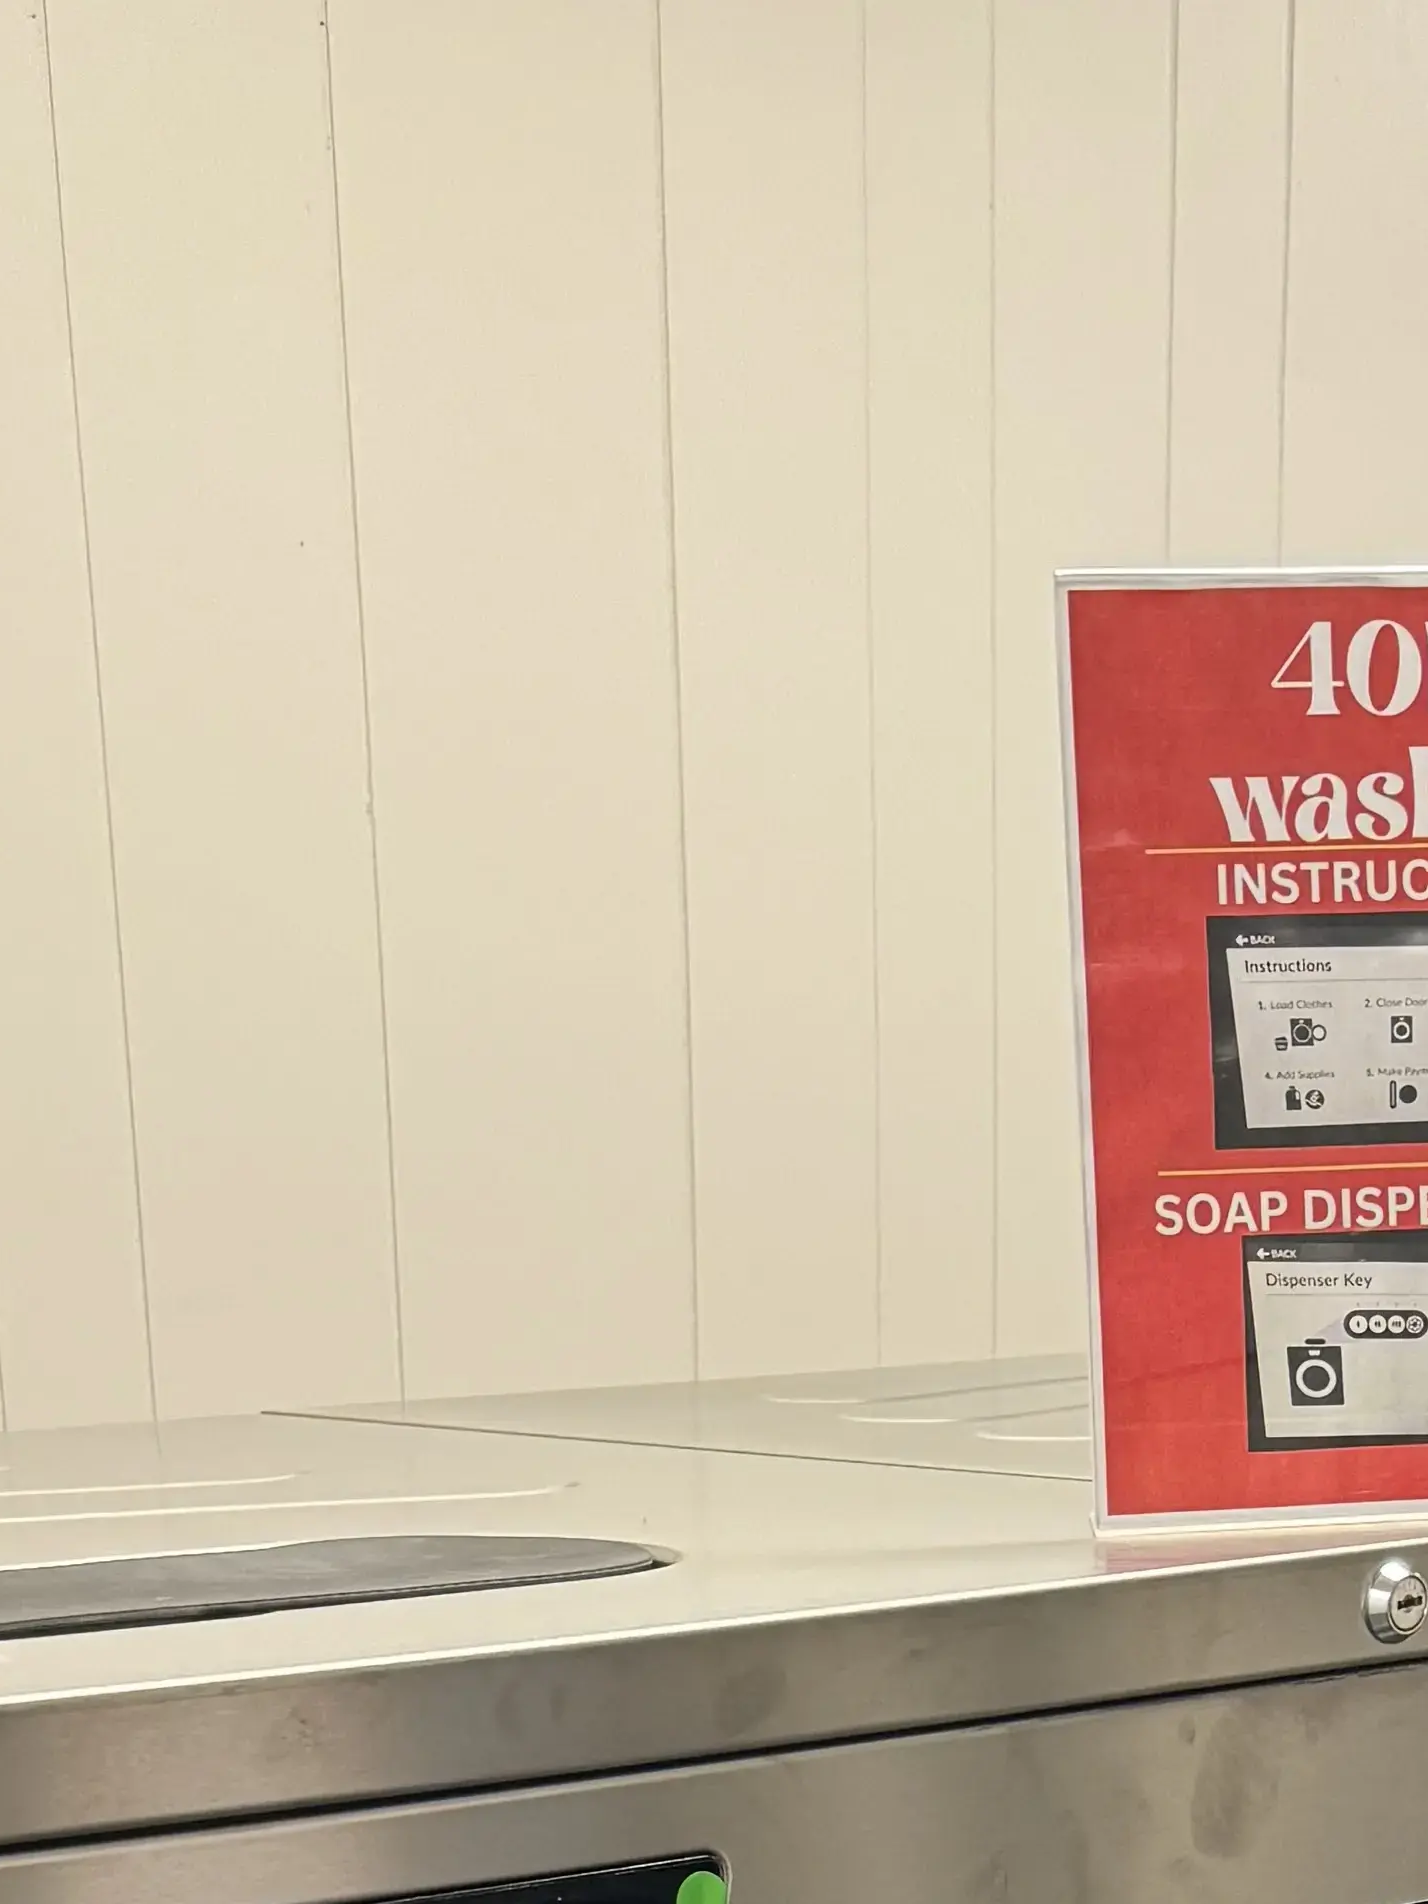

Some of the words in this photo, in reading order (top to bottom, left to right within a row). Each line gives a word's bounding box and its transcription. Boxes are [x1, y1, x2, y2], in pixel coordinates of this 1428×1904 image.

[1245, 958, 1332, 973] Instructions
[1155, 1191, 1288, 1236] SOAP
[1271, 1249, 1297, 1259] BACK
[1265, 1273, 1339, 1289] Dispenser
[1344, 1272, 1373, 1289] Key
